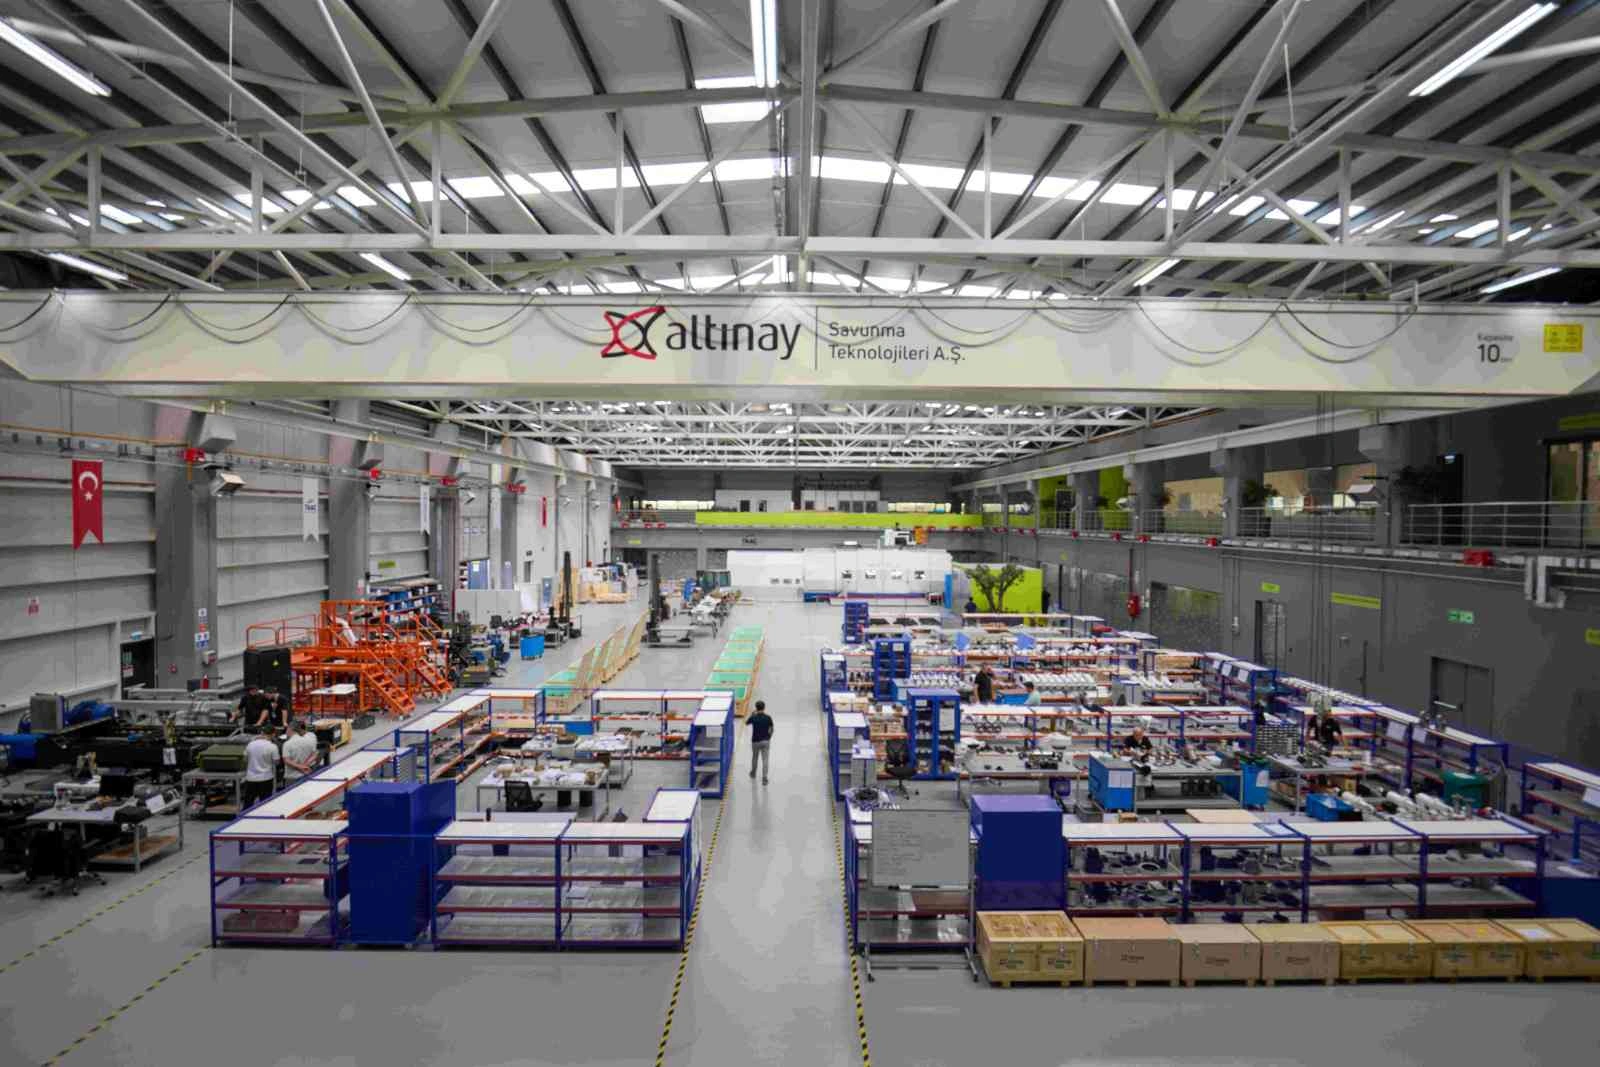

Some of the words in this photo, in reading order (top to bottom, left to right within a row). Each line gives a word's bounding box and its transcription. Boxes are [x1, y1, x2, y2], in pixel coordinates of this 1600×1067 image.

[665, 314, 801, 361] altınay
[829, 321, 906, 338] Savunma
[829, 344, 929, 363] Teknolojileri
[933, 346, 966, 365] A.Ş.
[1477, 343, 1501, 363] 10
